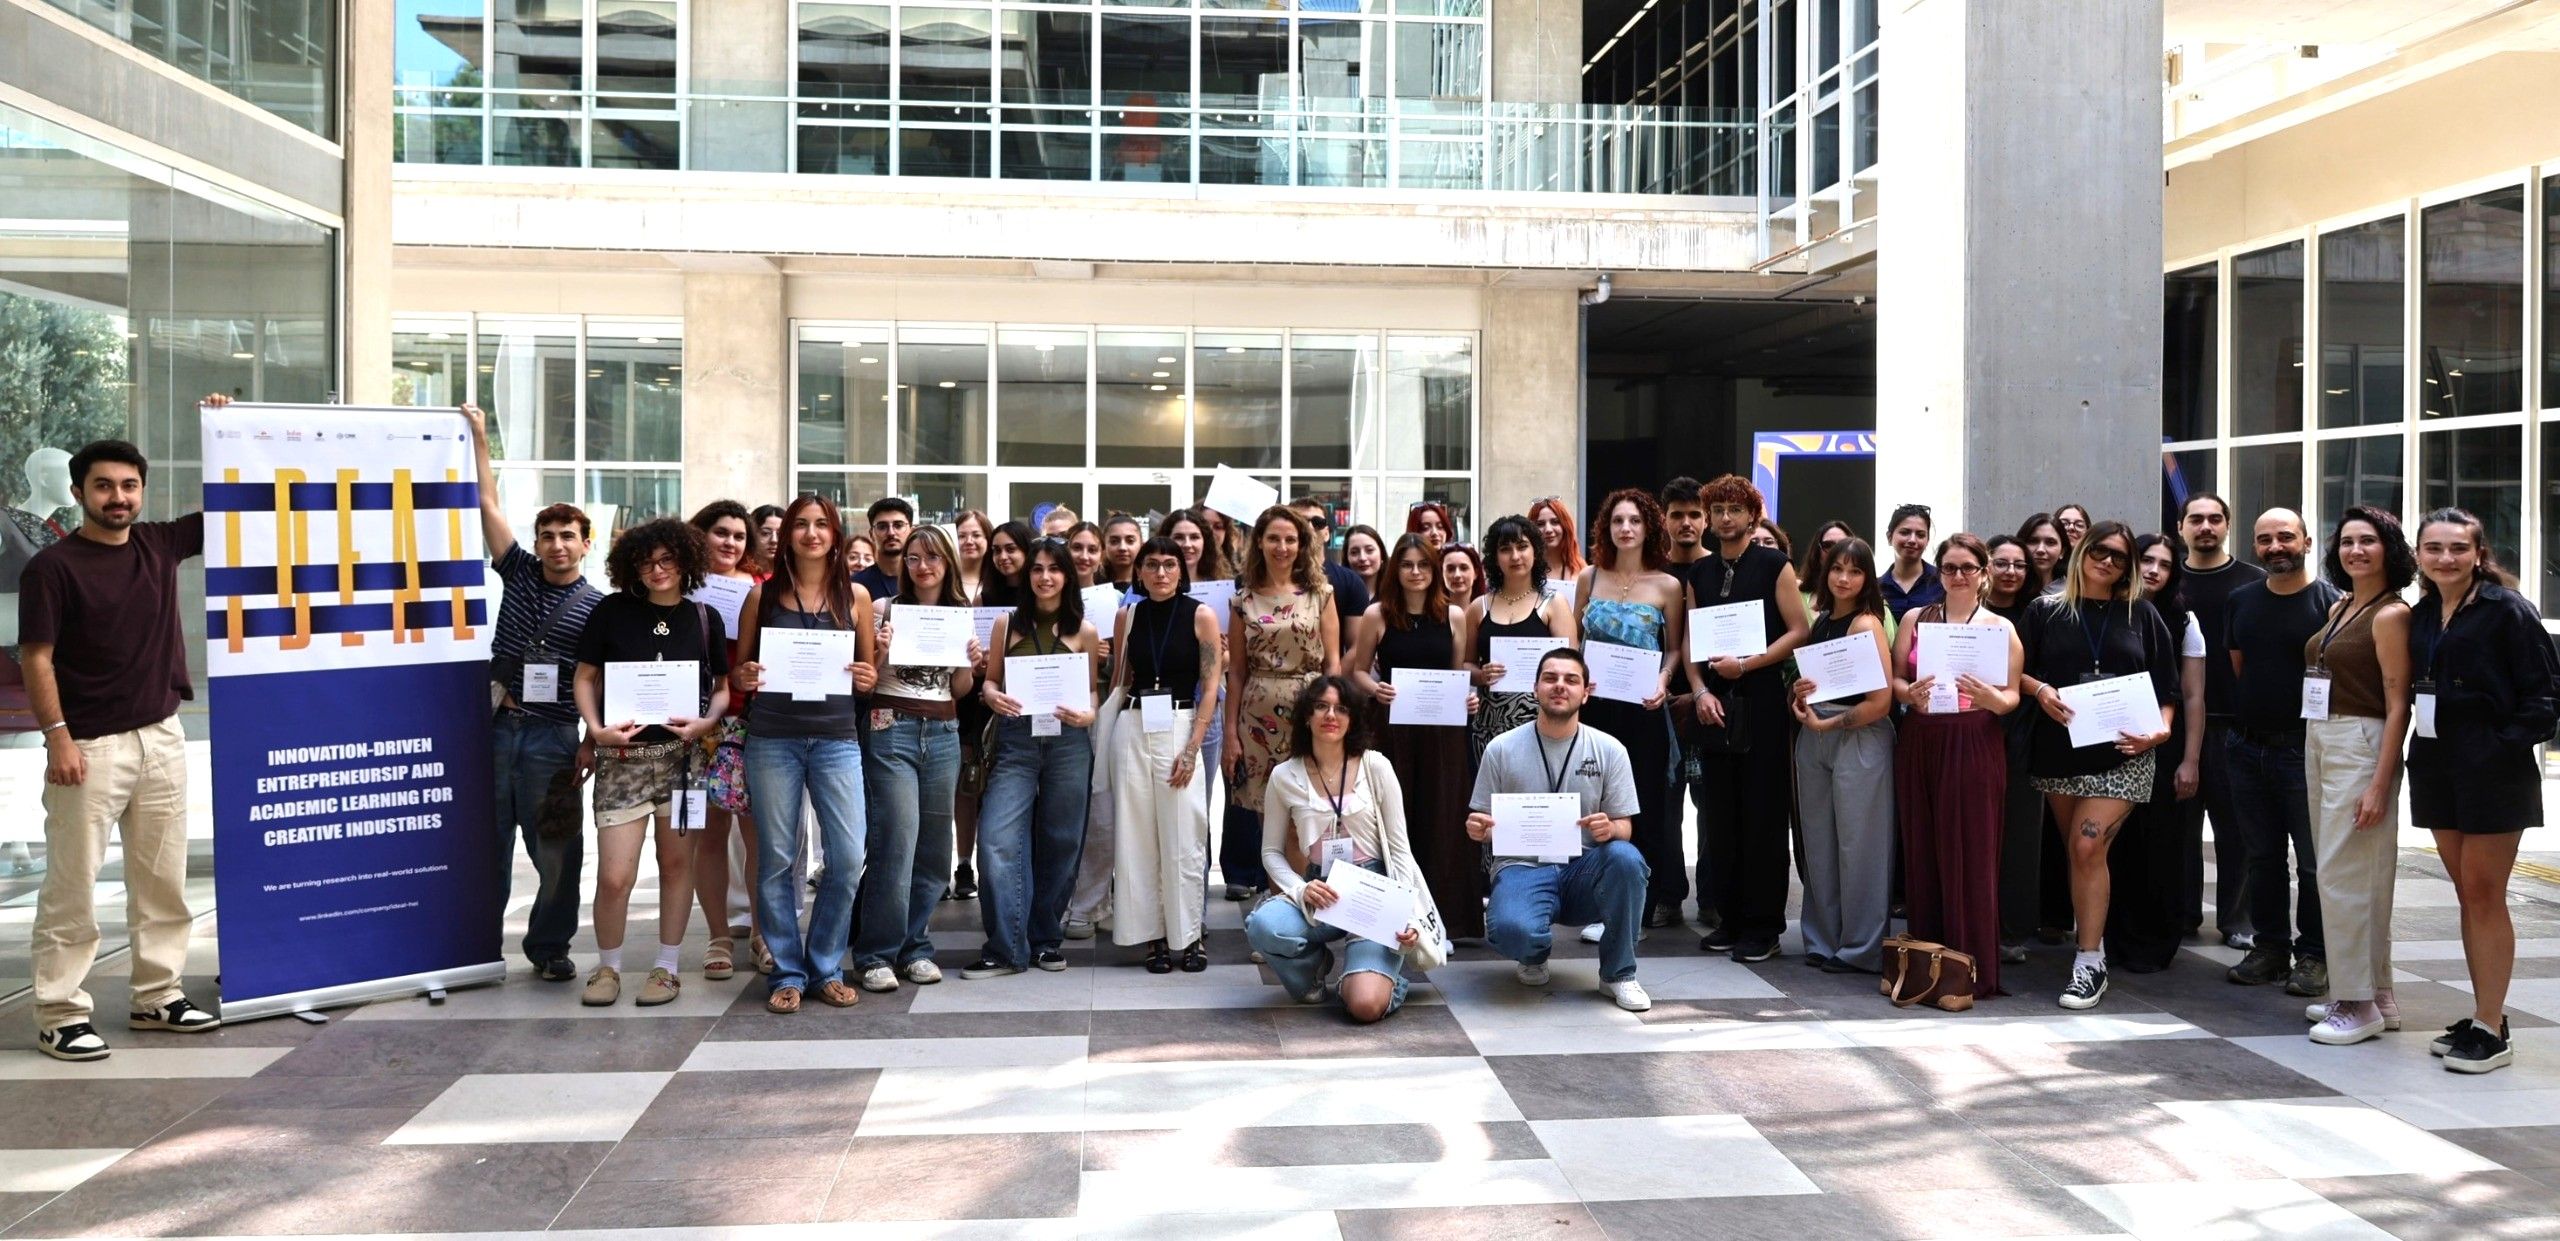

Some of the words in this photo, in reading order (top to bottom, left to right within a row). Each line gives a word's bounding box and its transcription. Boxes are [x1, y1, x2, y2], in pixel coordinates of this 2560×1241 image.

[223, 468, 475, 653] IDEAL
[268, 737, 433, 766] INNOVATION-DRIVEN
[257, 765, 409, 794] ENTREPRENEURSIP
[411, 762, 445, 779] AND
[249, 797, 338, 822] ACADEMIC
[341, 789, 420, 812] LEARNING
[422, 786, 453, 804] FOR
[264, 823, 343, 847] CREATIVE
[346, 813, 442, 838] INDUSTRIES
[292, 880, 321, 888] turning
[322, 874, 357, 885] research
[374, 867, 413, 879] real-world
[414, 865, 448, 874] solutions
